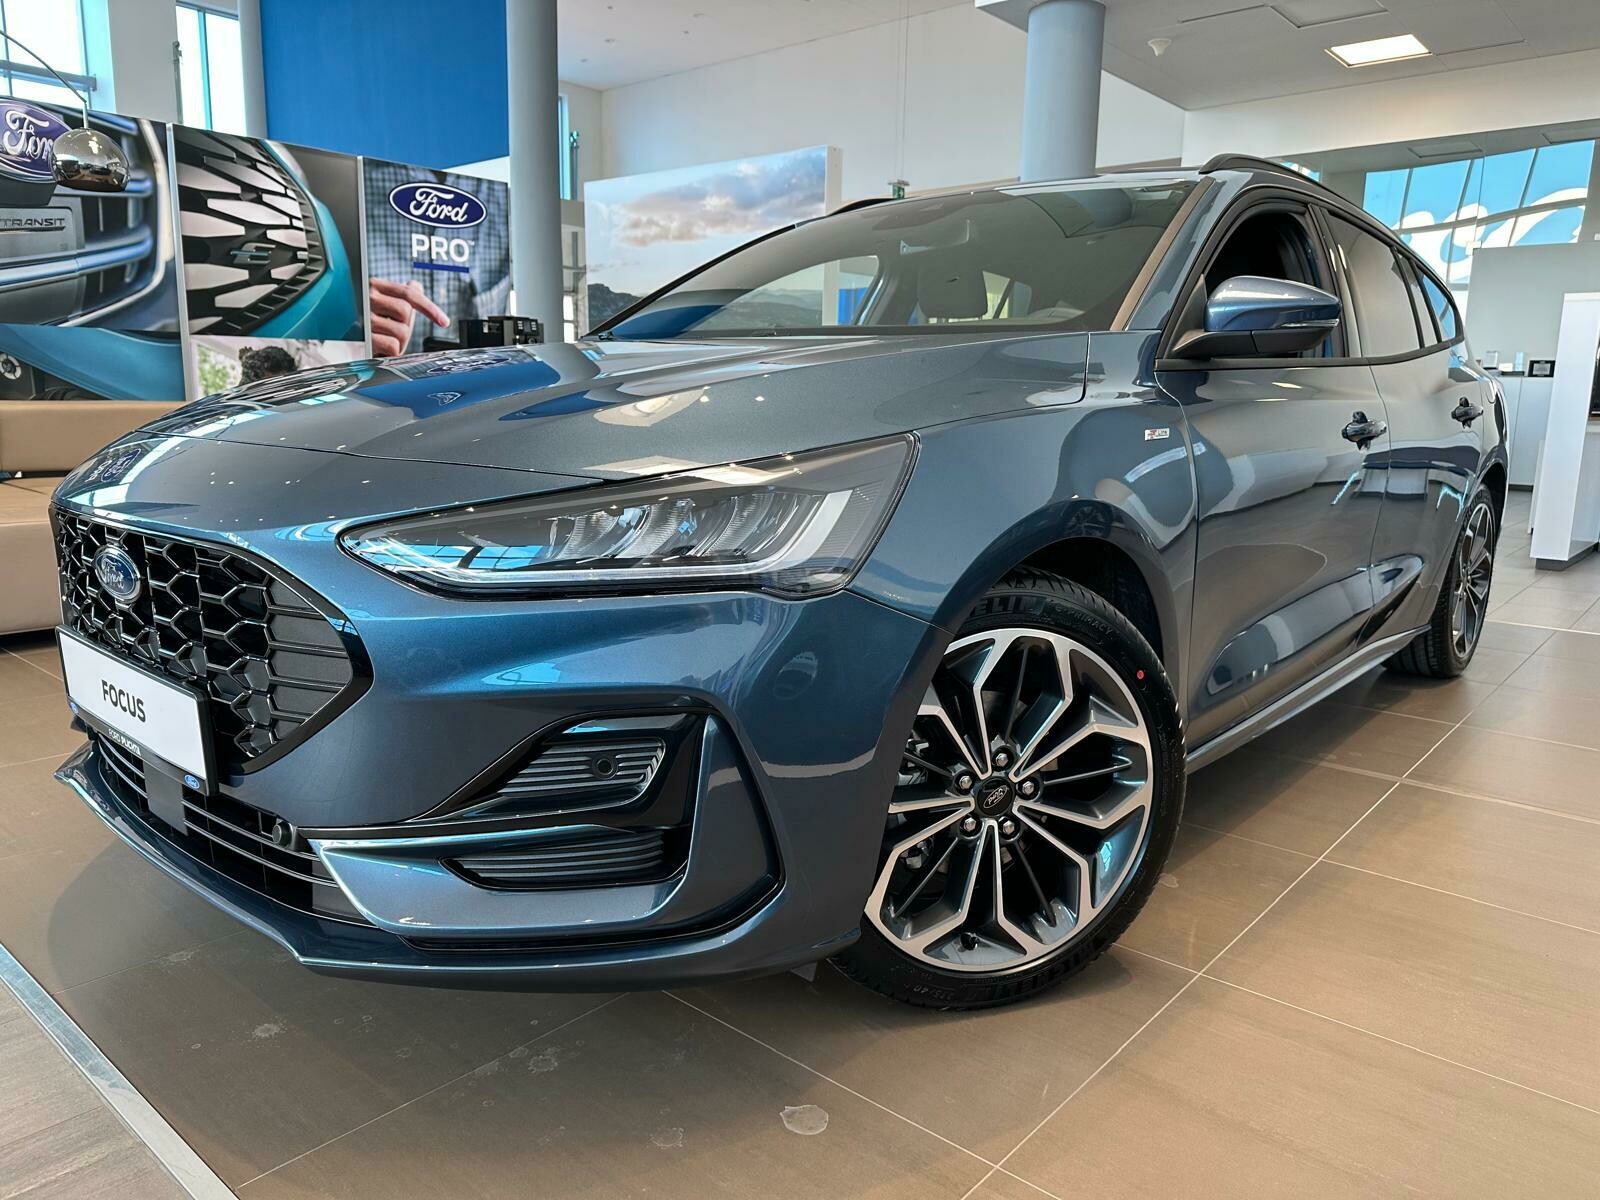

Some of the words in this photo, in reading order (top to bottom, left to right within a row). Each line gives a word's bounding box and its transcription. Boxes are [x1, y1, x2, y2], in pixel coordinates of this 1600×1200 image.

[3, 110, 55, 162] For
[0, 218, 65, 227] TRANSIT
[409, 187, 469, 222] Ford
[101, 680, 146, 722] FOCUS
